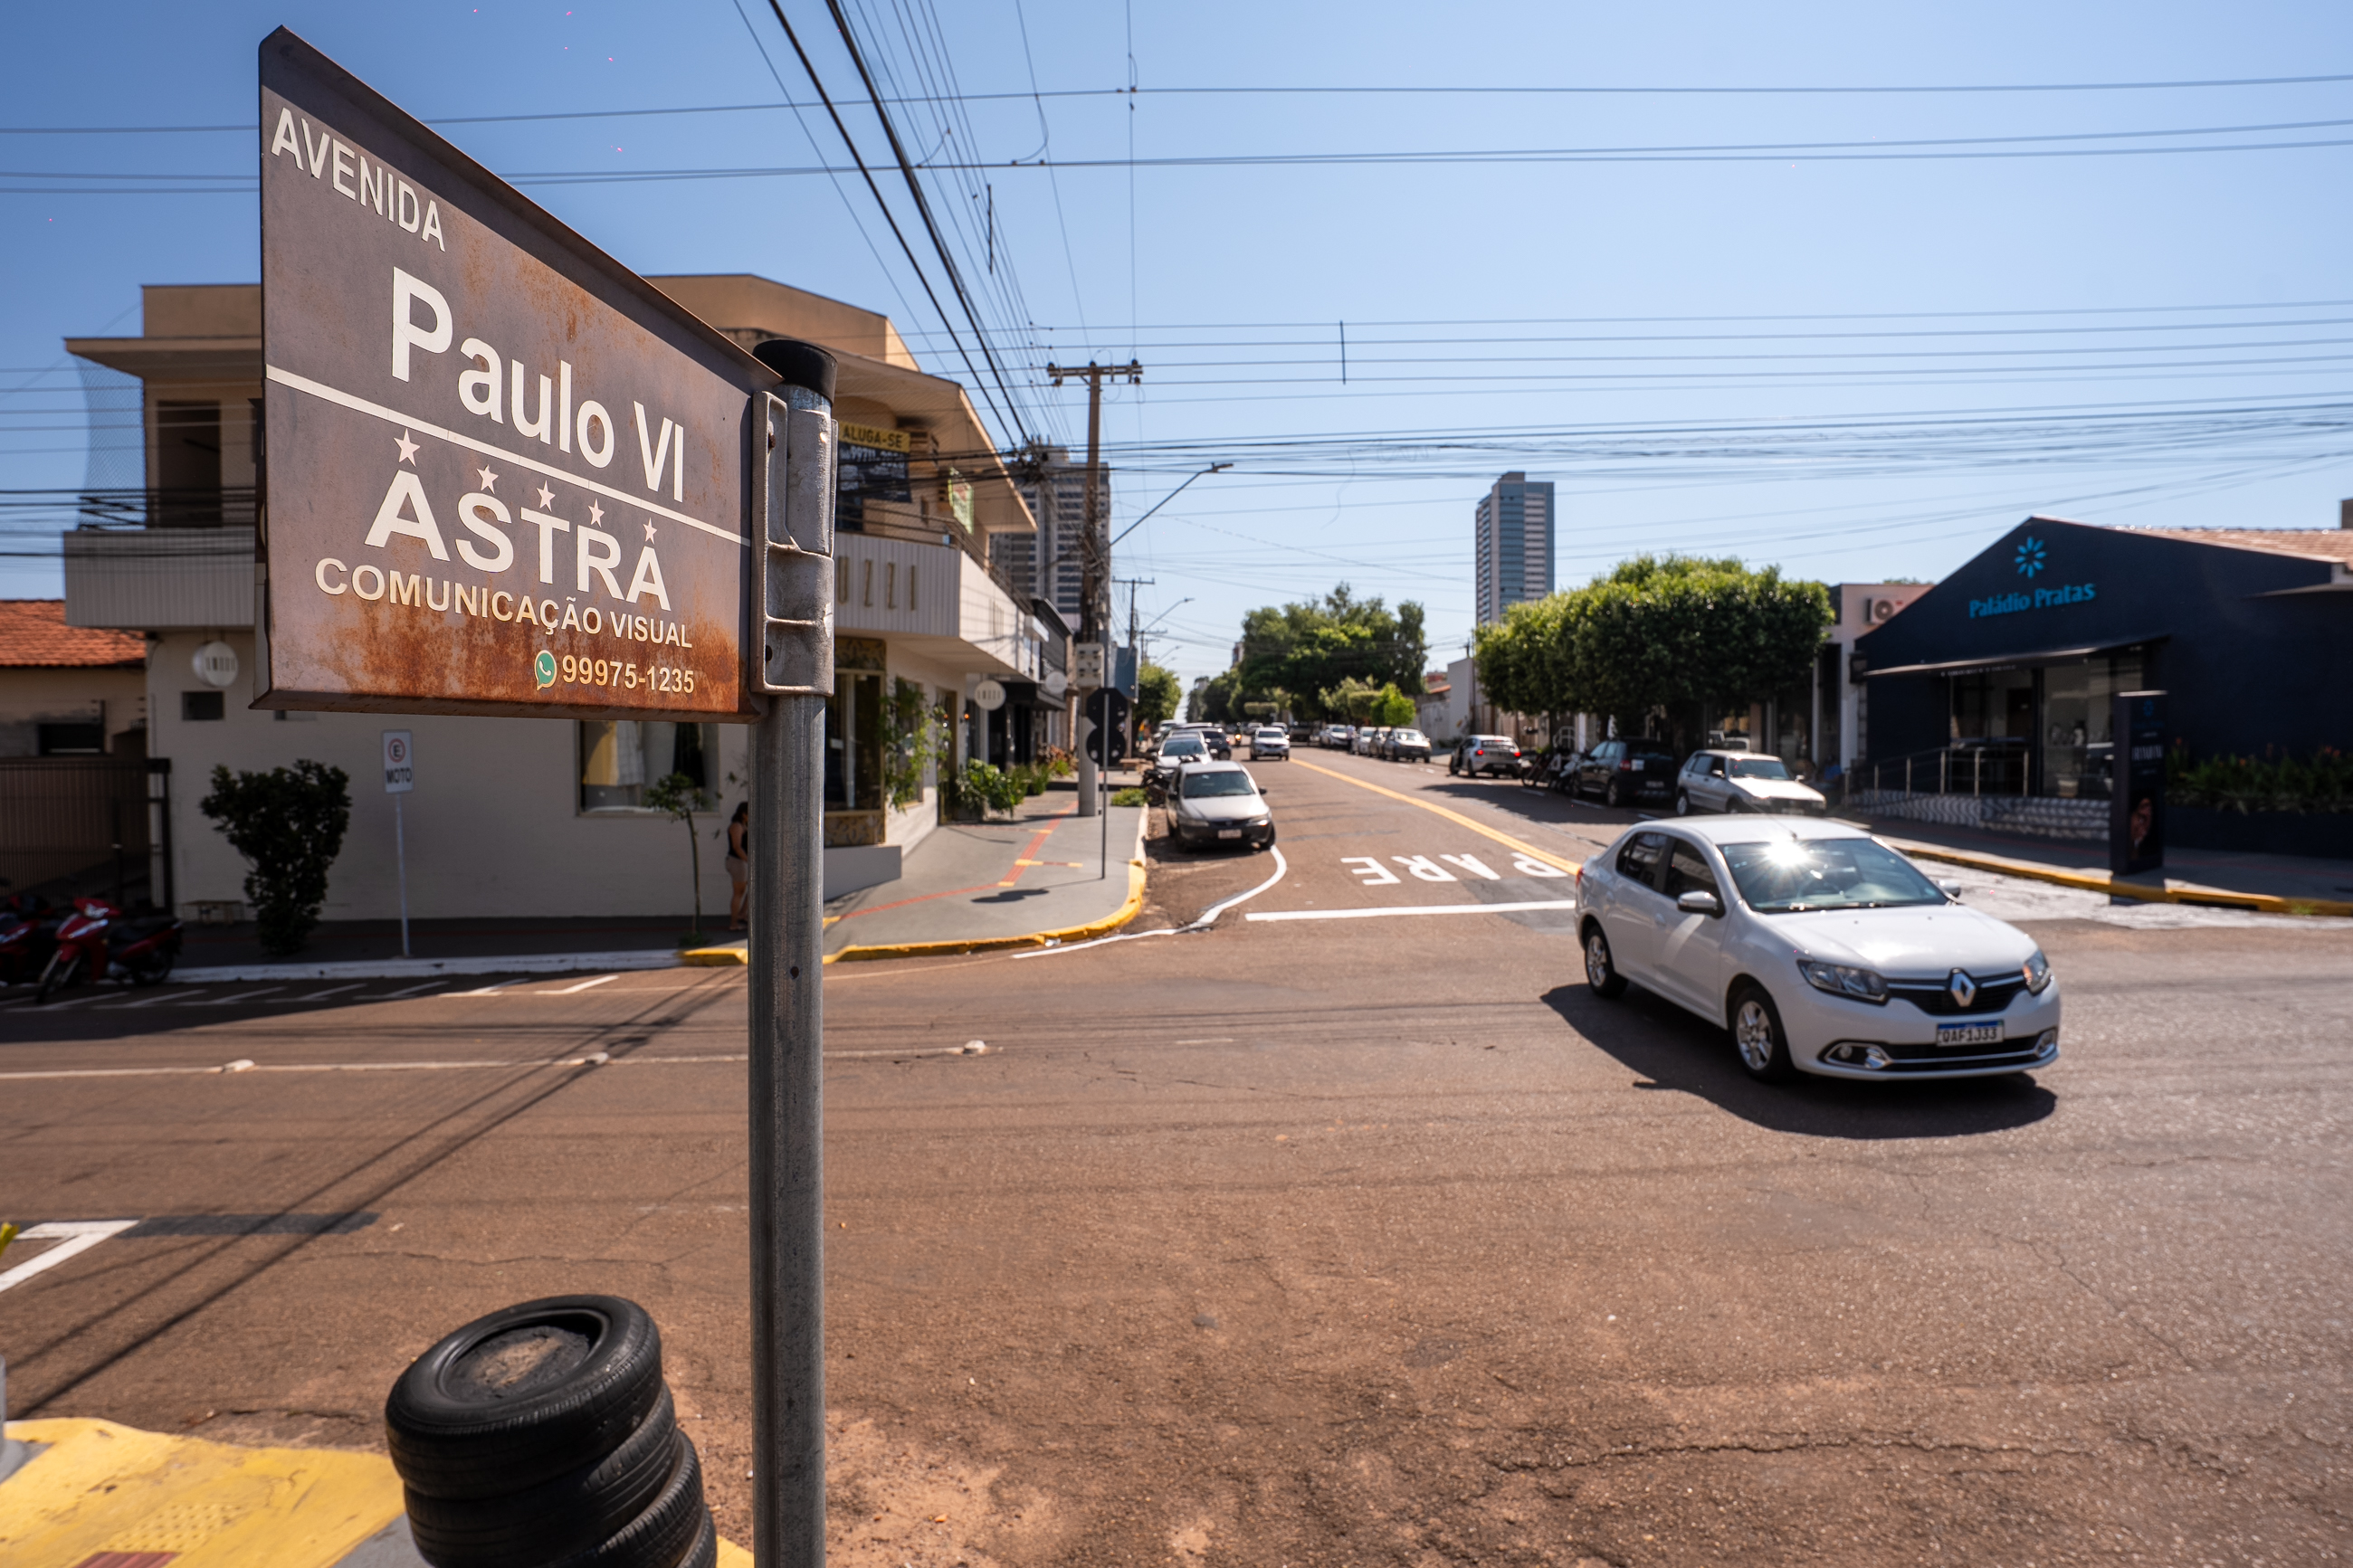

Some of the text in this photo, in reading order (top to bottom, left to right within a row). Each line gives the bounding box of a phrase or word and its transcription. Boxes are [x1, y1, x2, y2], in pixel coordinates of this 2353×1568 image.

[271, 108, 445, 252] AVENIDA
[392, 266, 684, 503] Paulo VI
[842, 425, 903, 448] ALUGA-SE
[364, 469, 672, 612] ASTRA
[314, 557, 693, 649] COMUNICAÇÃO VISUAL
[837, 556, 916, 612] UZZI
[2034, 584, 2097, 609] Pratas
[562, 654, 695, 695] 99975-1235
[393, 744, 402, 758] E
[386, 767, 413, 784] MOTO
